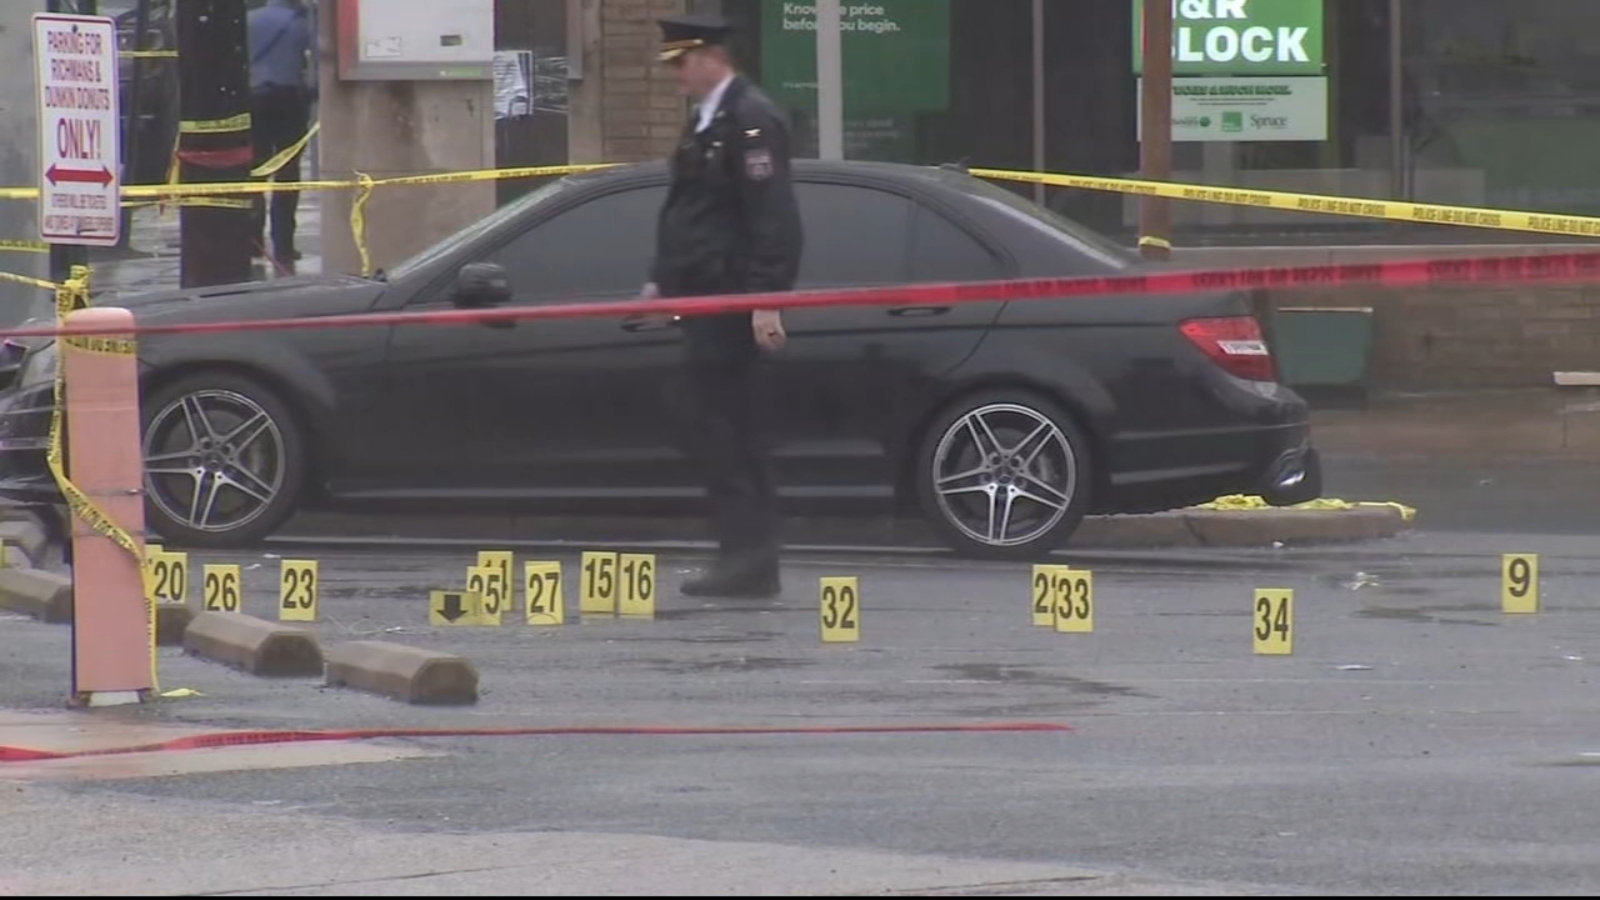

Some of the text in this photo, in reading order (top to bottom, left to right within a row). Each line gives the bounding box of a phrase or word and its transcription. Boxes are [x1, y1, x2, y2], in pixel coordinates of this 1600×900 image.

[783, 18, 901, 34] befo ou begin.
[850, 3, 884, 17] price
[1172, 0, 1247, 19] &R
[85, 33, 102, 55] FOR
[1172, 26, 1310, 62] LOCK
[57, 118, 101, 160] ONLY!
[1250, 115, 1288, 129] Spruce
[1349, 202, 1361, 213] NOT
[1413, 207, 1436, 219] POLICE
[1453, 210, 1462, 222] DO
[1464, 211, 1477, 224] NOT
[1528, 216, 1551, 229] POLICE
[1580, 220, 1593, 233] NOT
[154, 561, 184, 601] 20
[205, 572, 237, 612] 26
[282, 568, 314, 609] 23
[529, 572, 560, 613] 27
[585, 558, 612, 598] 15
[624, 560, 651, 600] 16
[1034, 573, 1056, 613] 2
[1508, 558, 1530, 597] 9
[822, 586, 855, 629] 32
[1058, 578, 1090, 619] 33
[1255, 597, 1289, 642] 34
